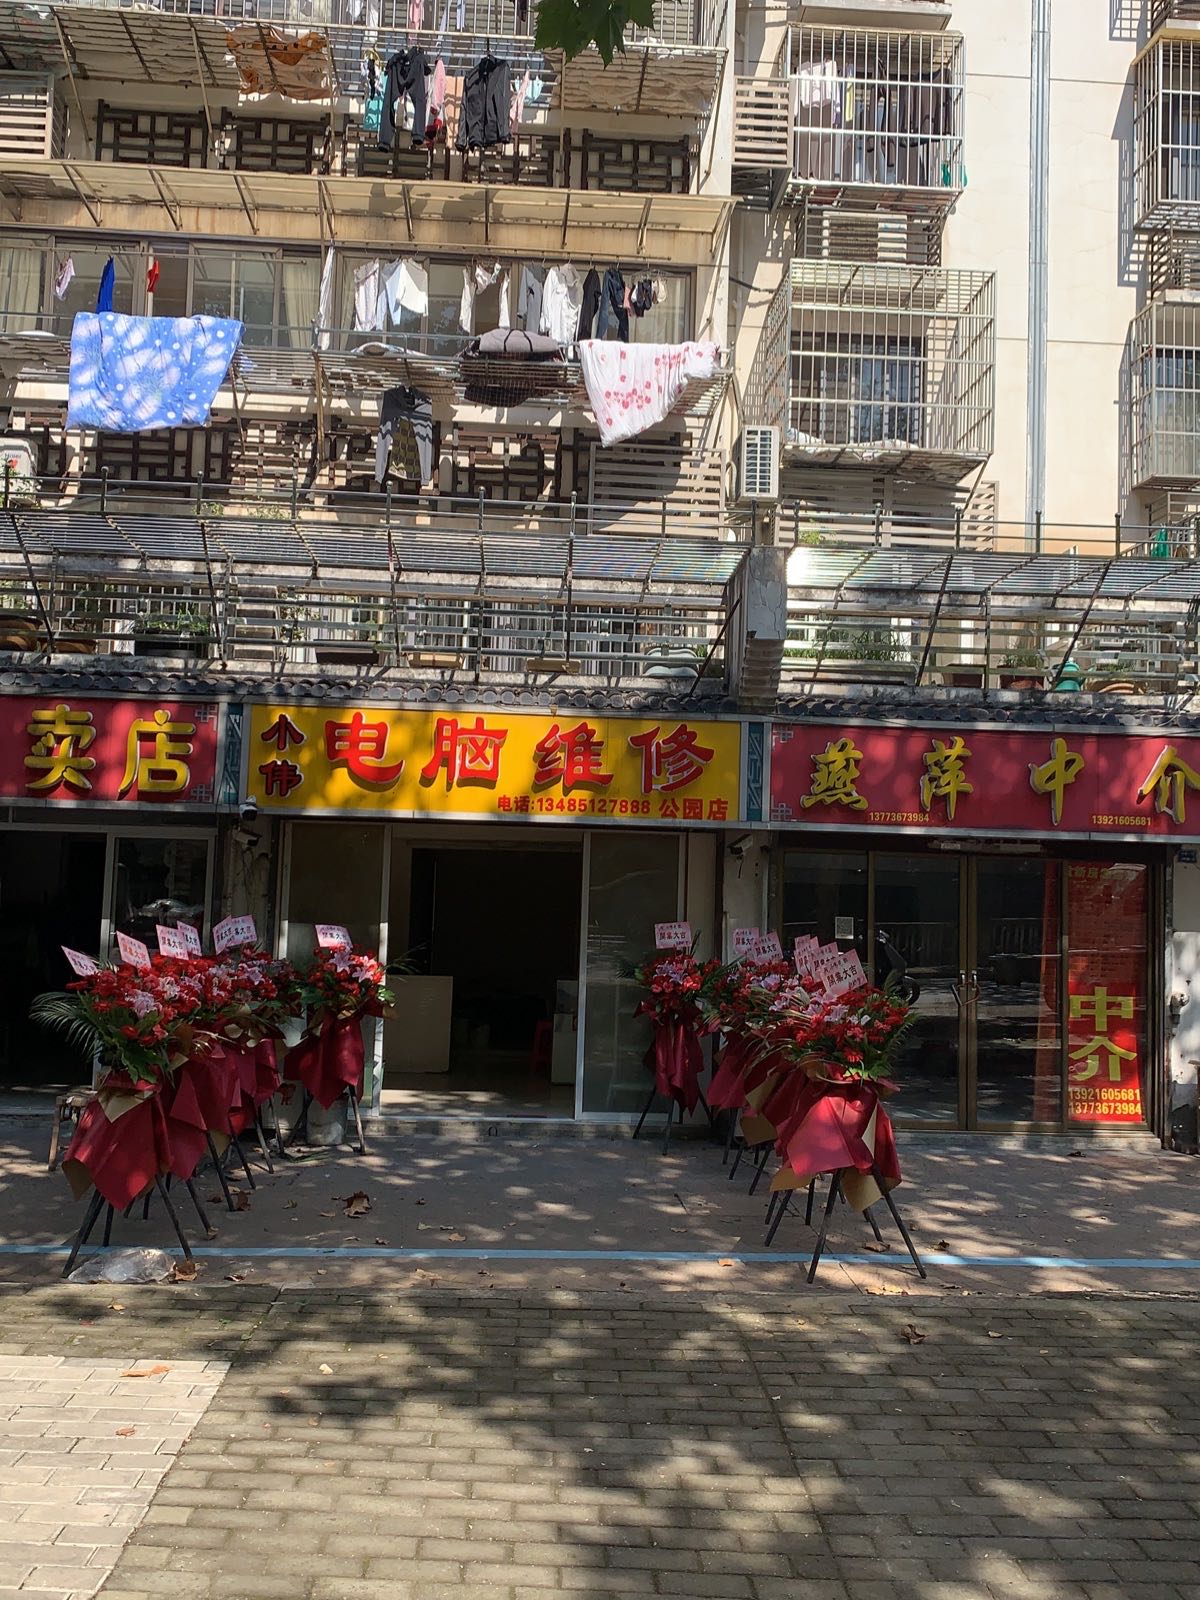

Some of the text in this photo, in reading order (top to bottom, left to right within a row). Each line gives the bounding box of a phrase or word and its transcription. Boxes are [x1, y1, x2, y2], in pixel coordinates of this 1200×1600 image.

[24, 704, 196, 800] 卖店
[258, 713, 304, 797] 小伟
[324, 711, 715, 794] 电脑维修
[659, 798, 728, 821] 公园店
[870, 812, 929, 822] 13773673984
[1092, 815, 1151, 826] 13921605681
[1068, 987, 1137, 1081] 中介
[1068, 1087, 1141, 1101] 13921605681
[1068, 1101, 1142, 1115] 13773673984
